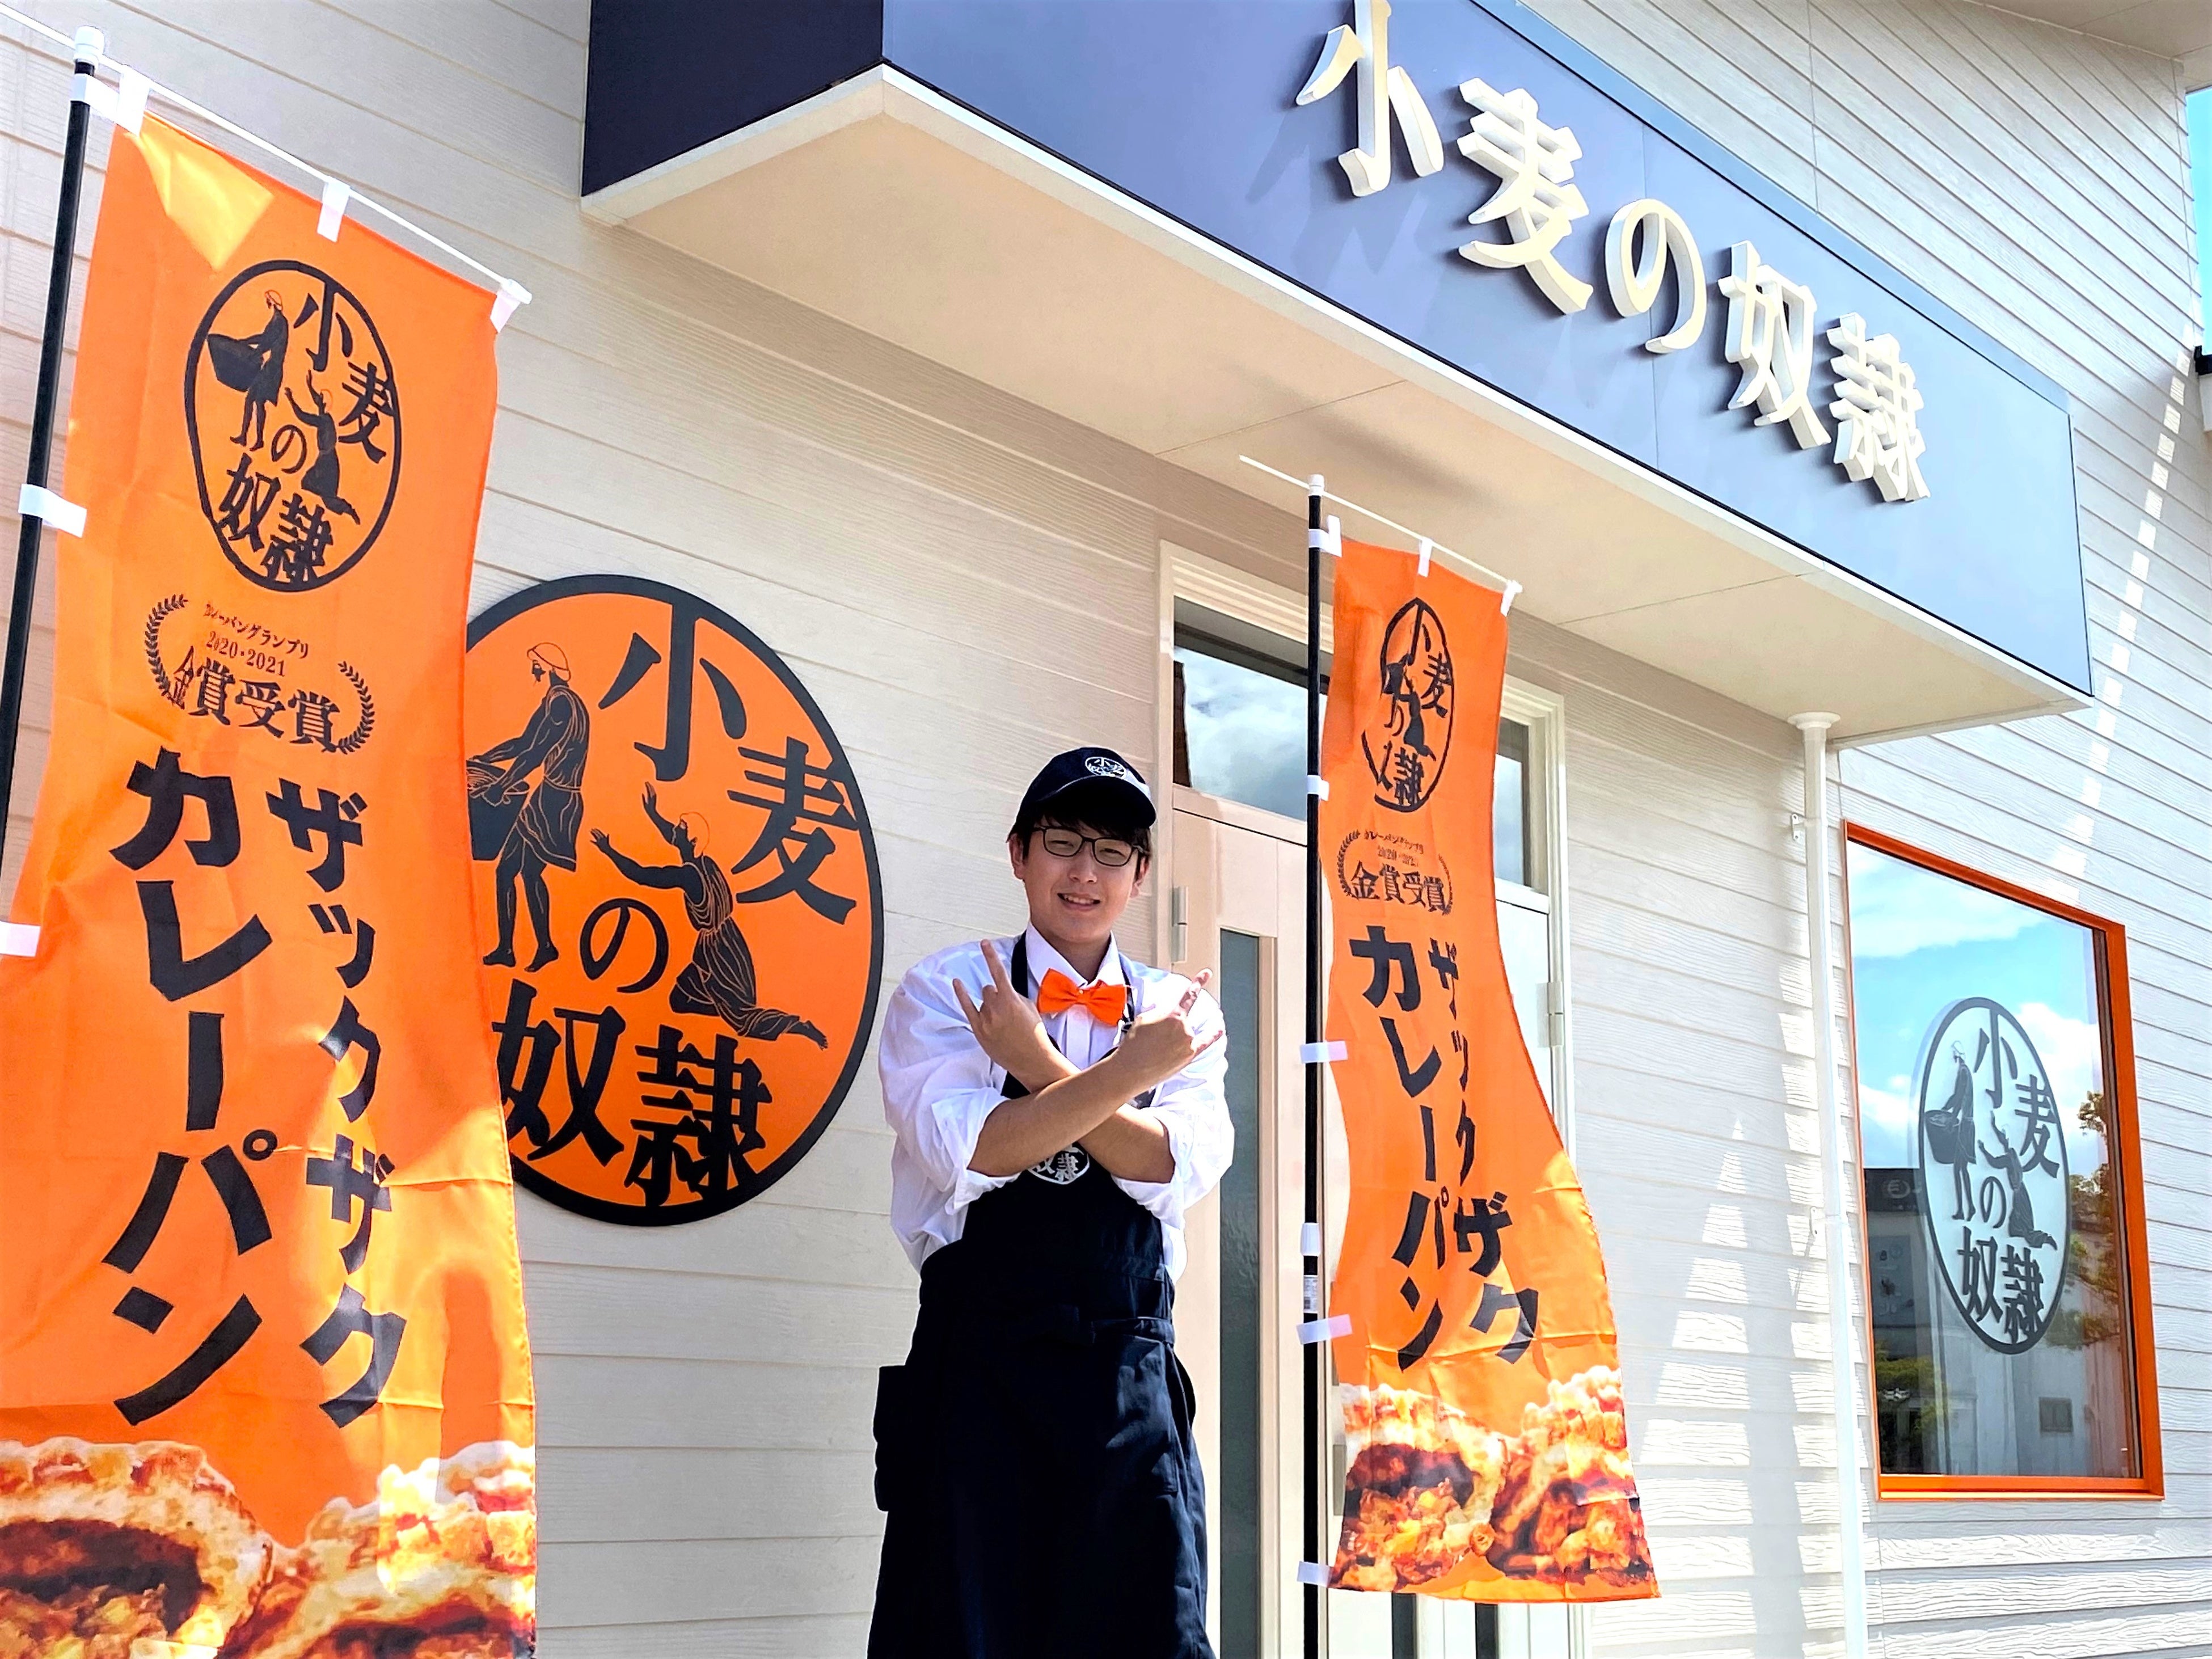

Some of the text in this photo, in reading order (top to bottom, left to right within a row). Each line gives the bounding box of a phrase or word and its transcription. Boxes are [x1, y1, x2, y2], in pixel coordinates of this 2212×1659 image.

[218, 282, 395, 581] 小麦の奴隷
[1295, 0, 1931, 501] 小麦の奴隷
[172, 645, 340, 753] 金賞受賞
[493, 602, 859, 1206] 小麦の奴隷
[1350, 860, 1447, 914] 金賞受賞
[102, 747, 278, 1426] カレーパン
[265, 778, 407, 1428] ザックザク
[1349, 925, 1449, 1372] カレーパン
[1956, 1008, 2058, 1343] 小麦の奴隷
